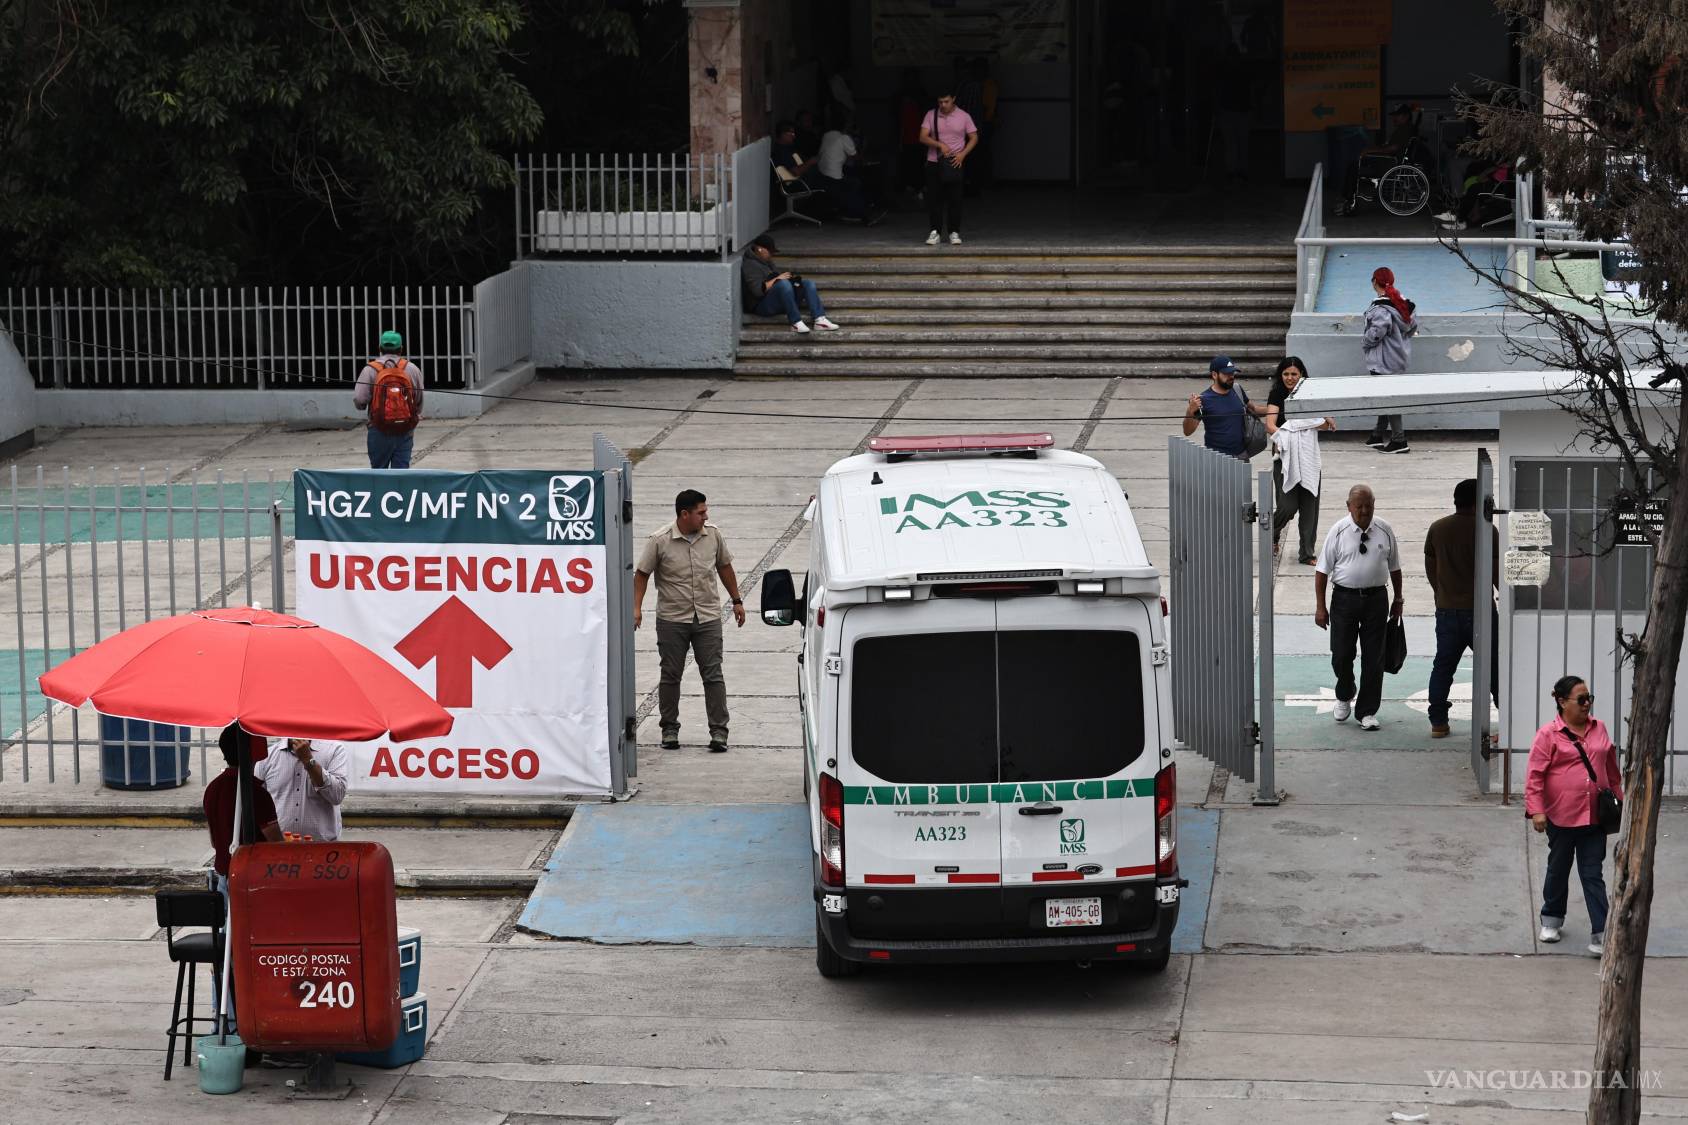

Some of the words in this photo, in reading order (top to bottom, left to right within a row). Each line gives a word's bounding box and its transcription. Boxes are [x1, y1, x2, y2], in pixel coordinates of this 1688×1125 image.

[306, 489, 371, 518] HGZ
[380, 489, 467, 522] C/MF
[518, 494, 537, 520] 2
[880, 490, 1071, 515] IMSS
[546, 521, 596, 541] IMSS
[895, 510, 1069, 534] AA323
[309, 553, 594, 595] URGENCIAS
[369, 747, 540, 780] ACCESO
[863, 779, 1140, 805] AMBULANCIA
[914, 826, 967, 842] AA323
[1060, 843, 1087, 854] IMSS
[1048, 905, 1100, 918] AM-405-GB
[311, 954, 351, 965] POSTAL
[312, 967, 347, 977] ZONA
[299, 981, 355, 1009] 240
